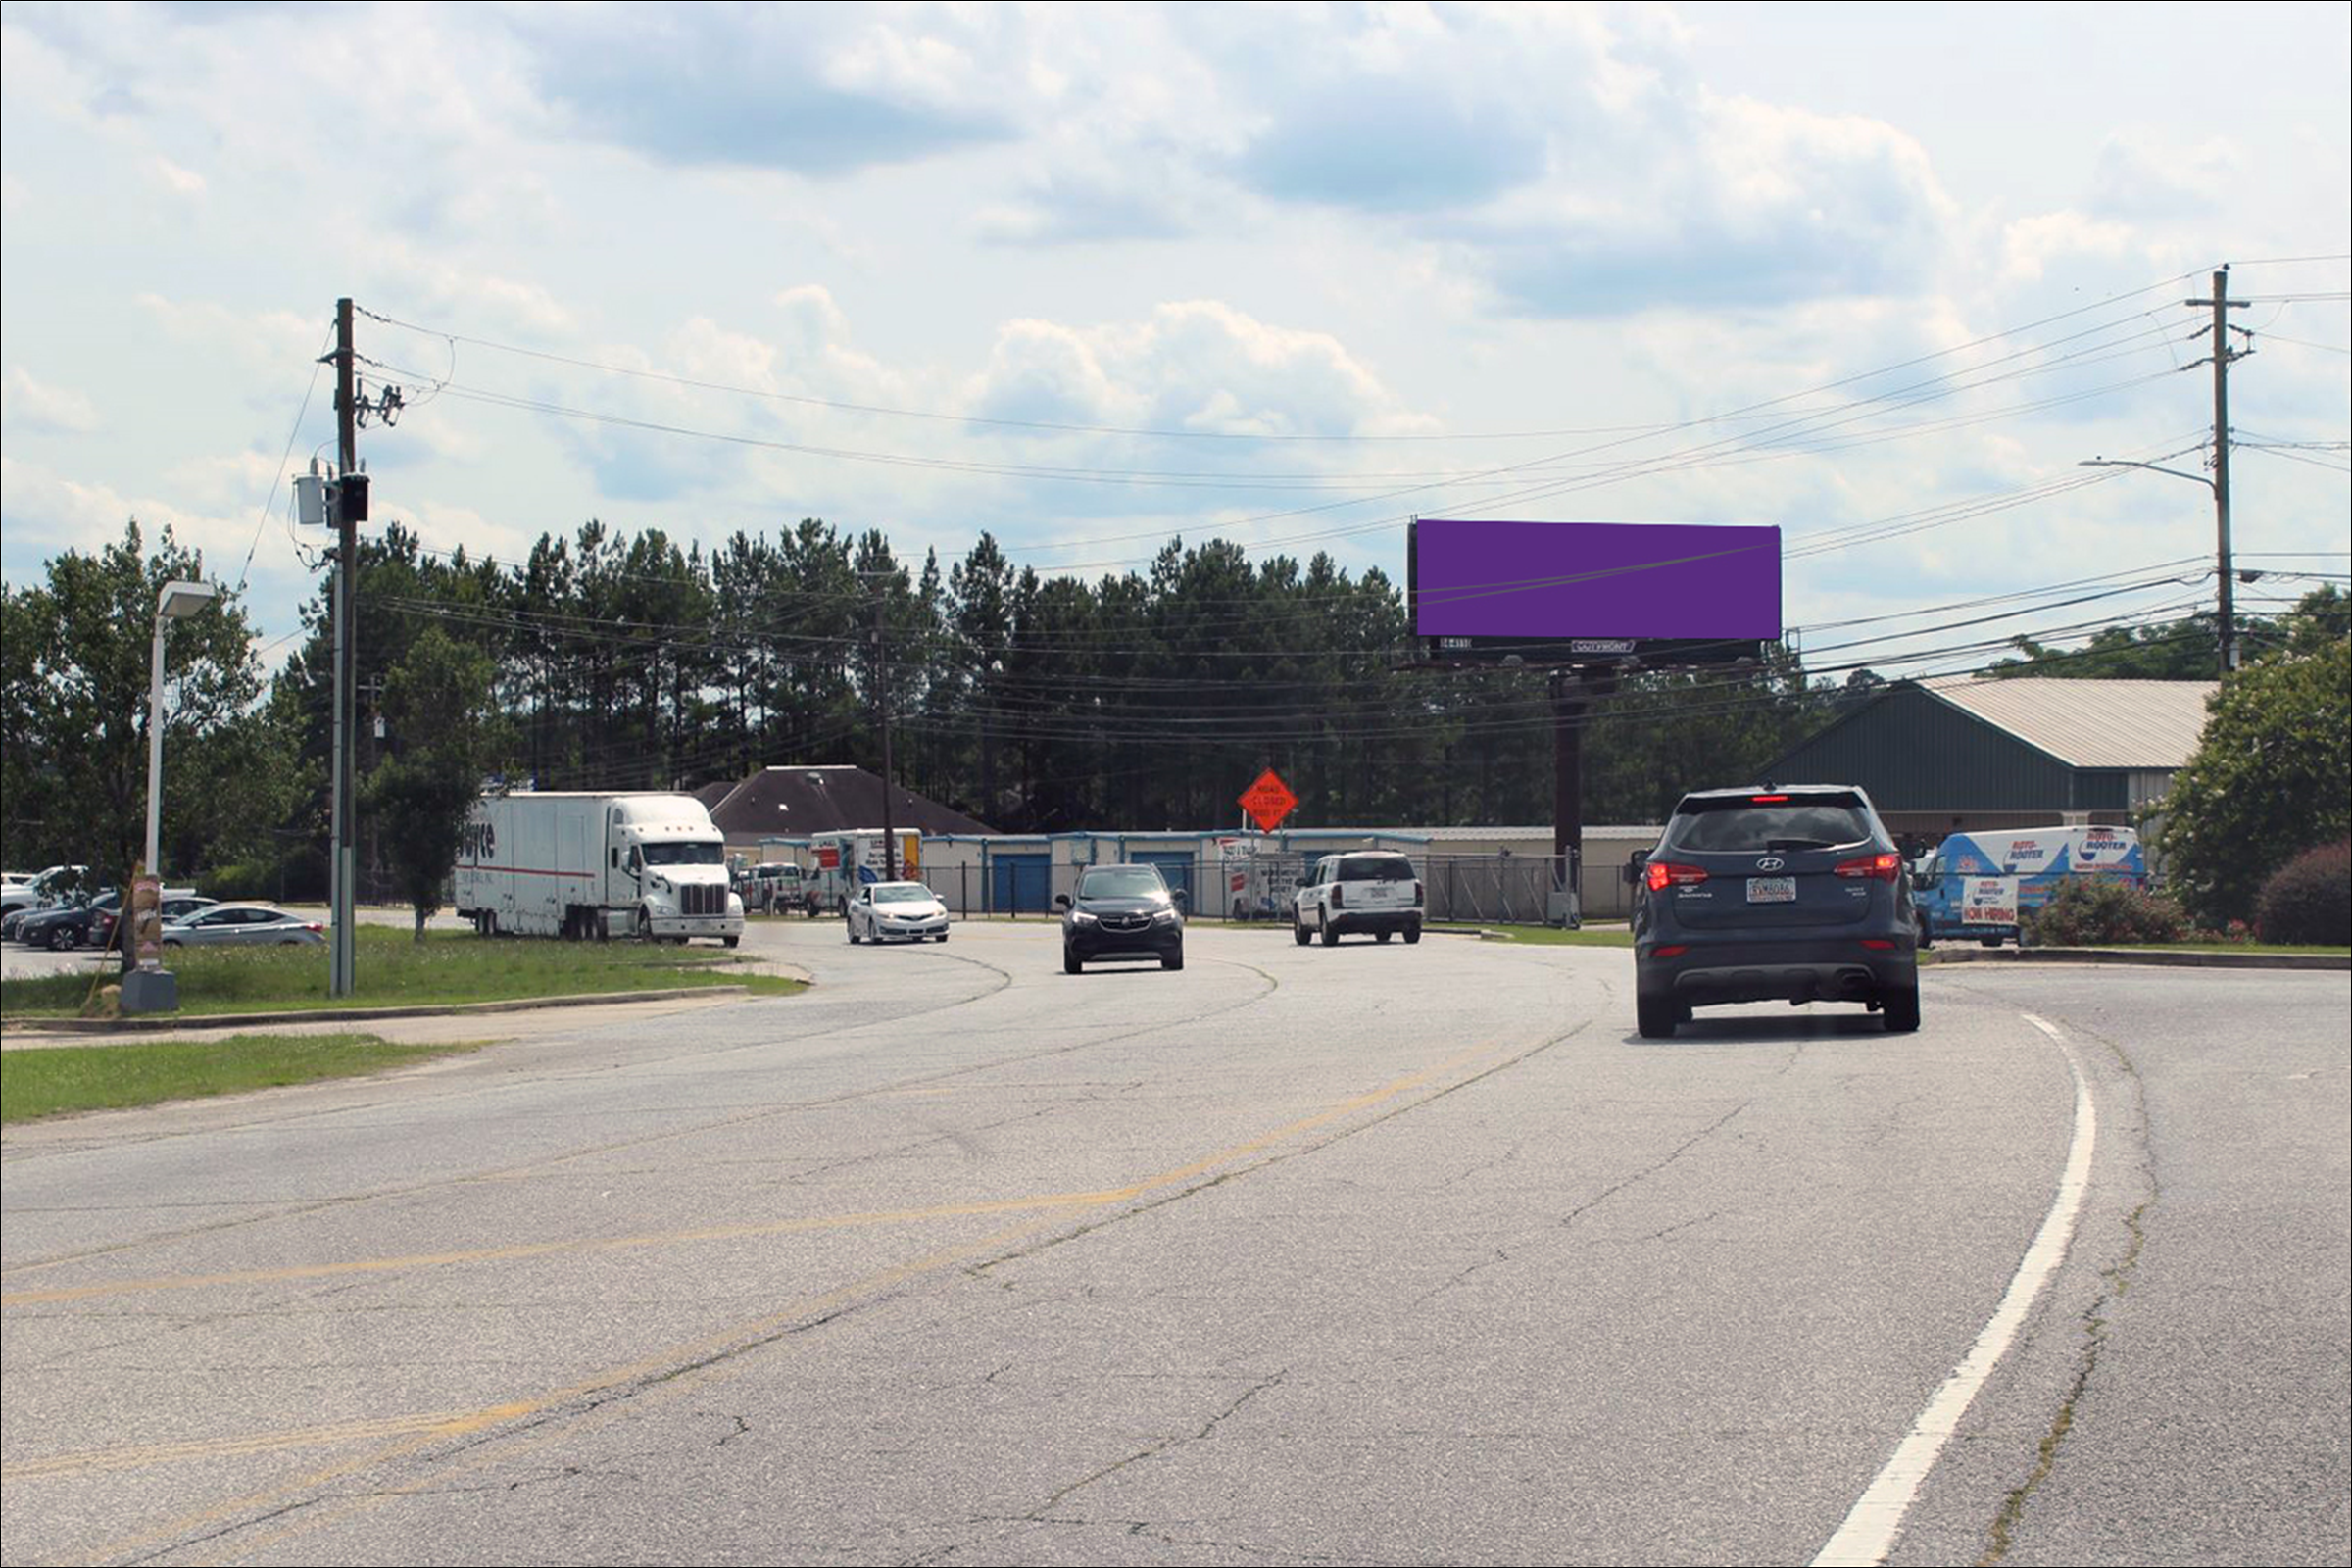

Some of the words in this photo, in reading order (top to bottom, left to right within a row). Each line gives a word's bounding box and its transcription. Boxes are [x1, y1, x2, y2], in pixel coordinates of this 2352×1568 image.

[1251, 796, 1286, 805] CLOSED
[2085, 841, 2127, 850] ROOTER
[2009, 850, 2044, 860] ROOTER
[1984, 907, 2015, 921] HIRING
